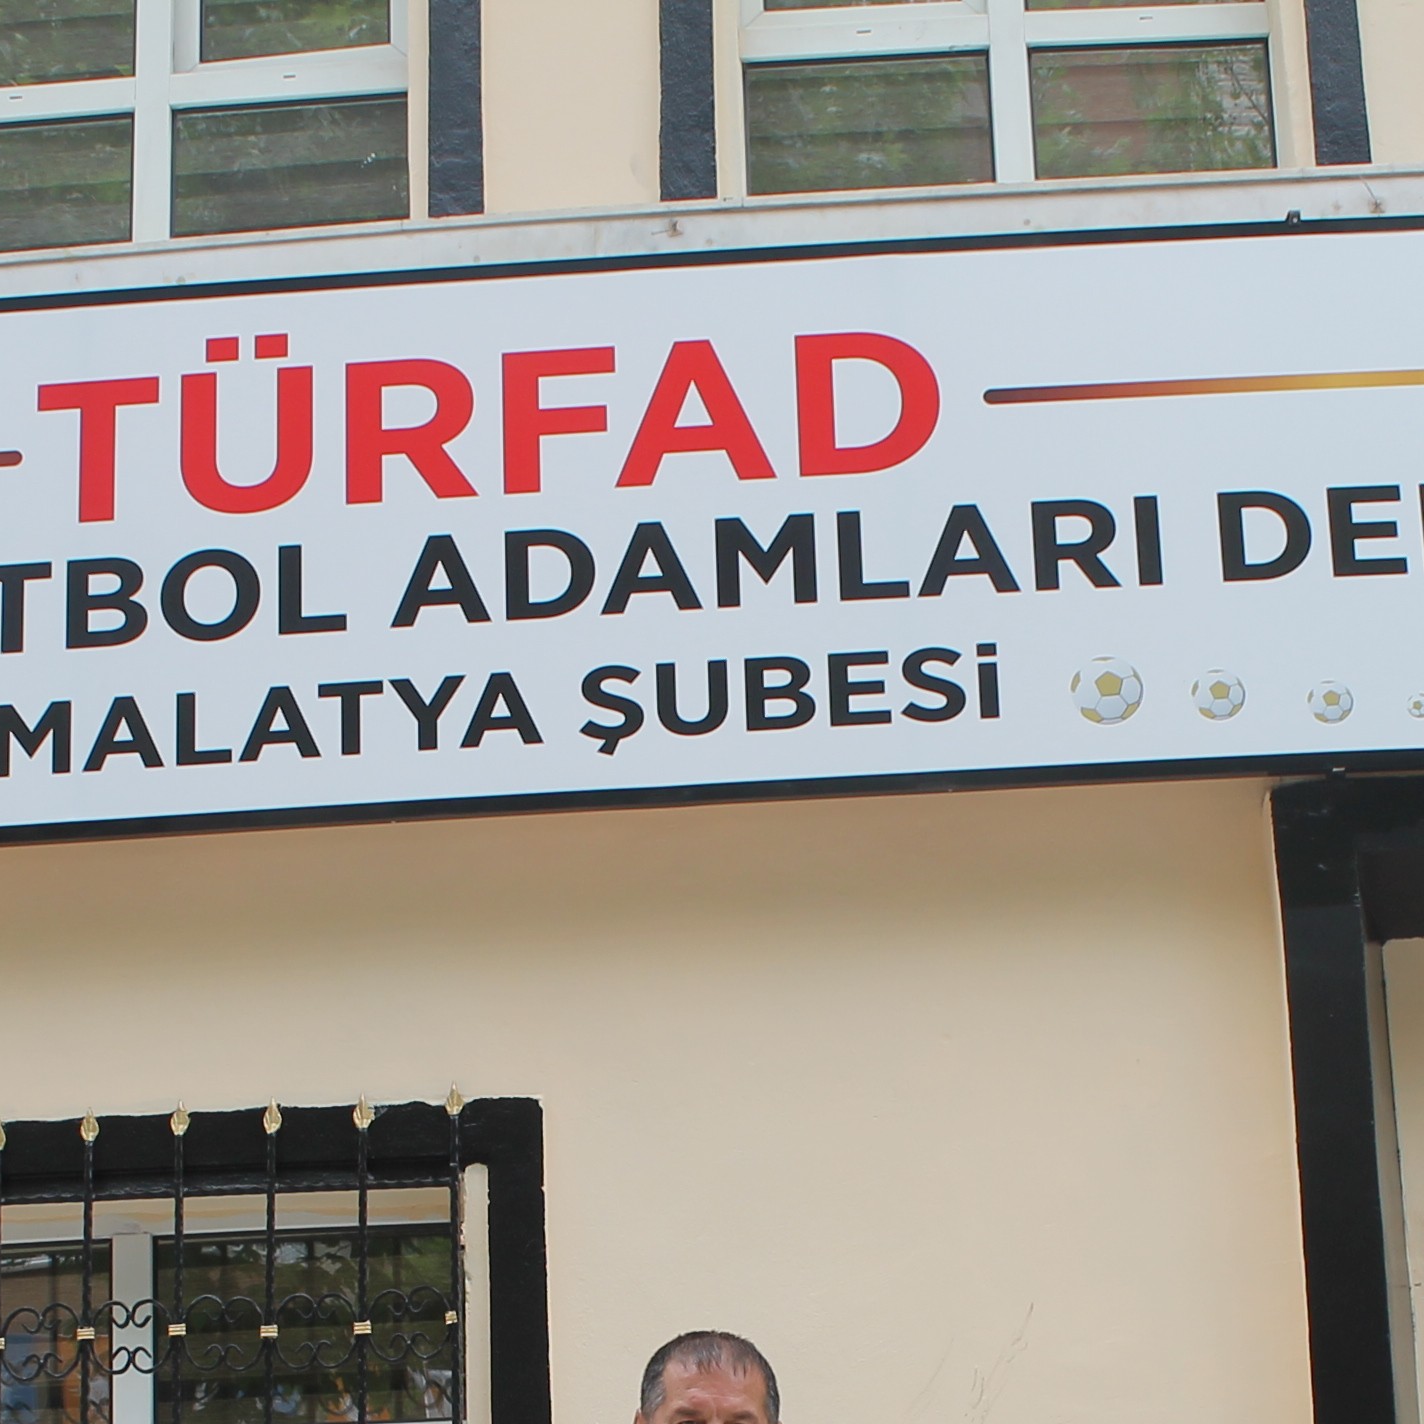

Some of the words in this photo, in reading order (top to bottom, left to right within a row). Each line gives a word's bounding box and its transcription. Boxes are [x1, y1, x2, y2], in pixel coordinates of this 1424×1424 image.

[37, 333, 940, 523] TÜRFAD
[390, 495, 1163, 628] ADAMLARI
[579, 642, 1000, 756] ŞUBESİ
